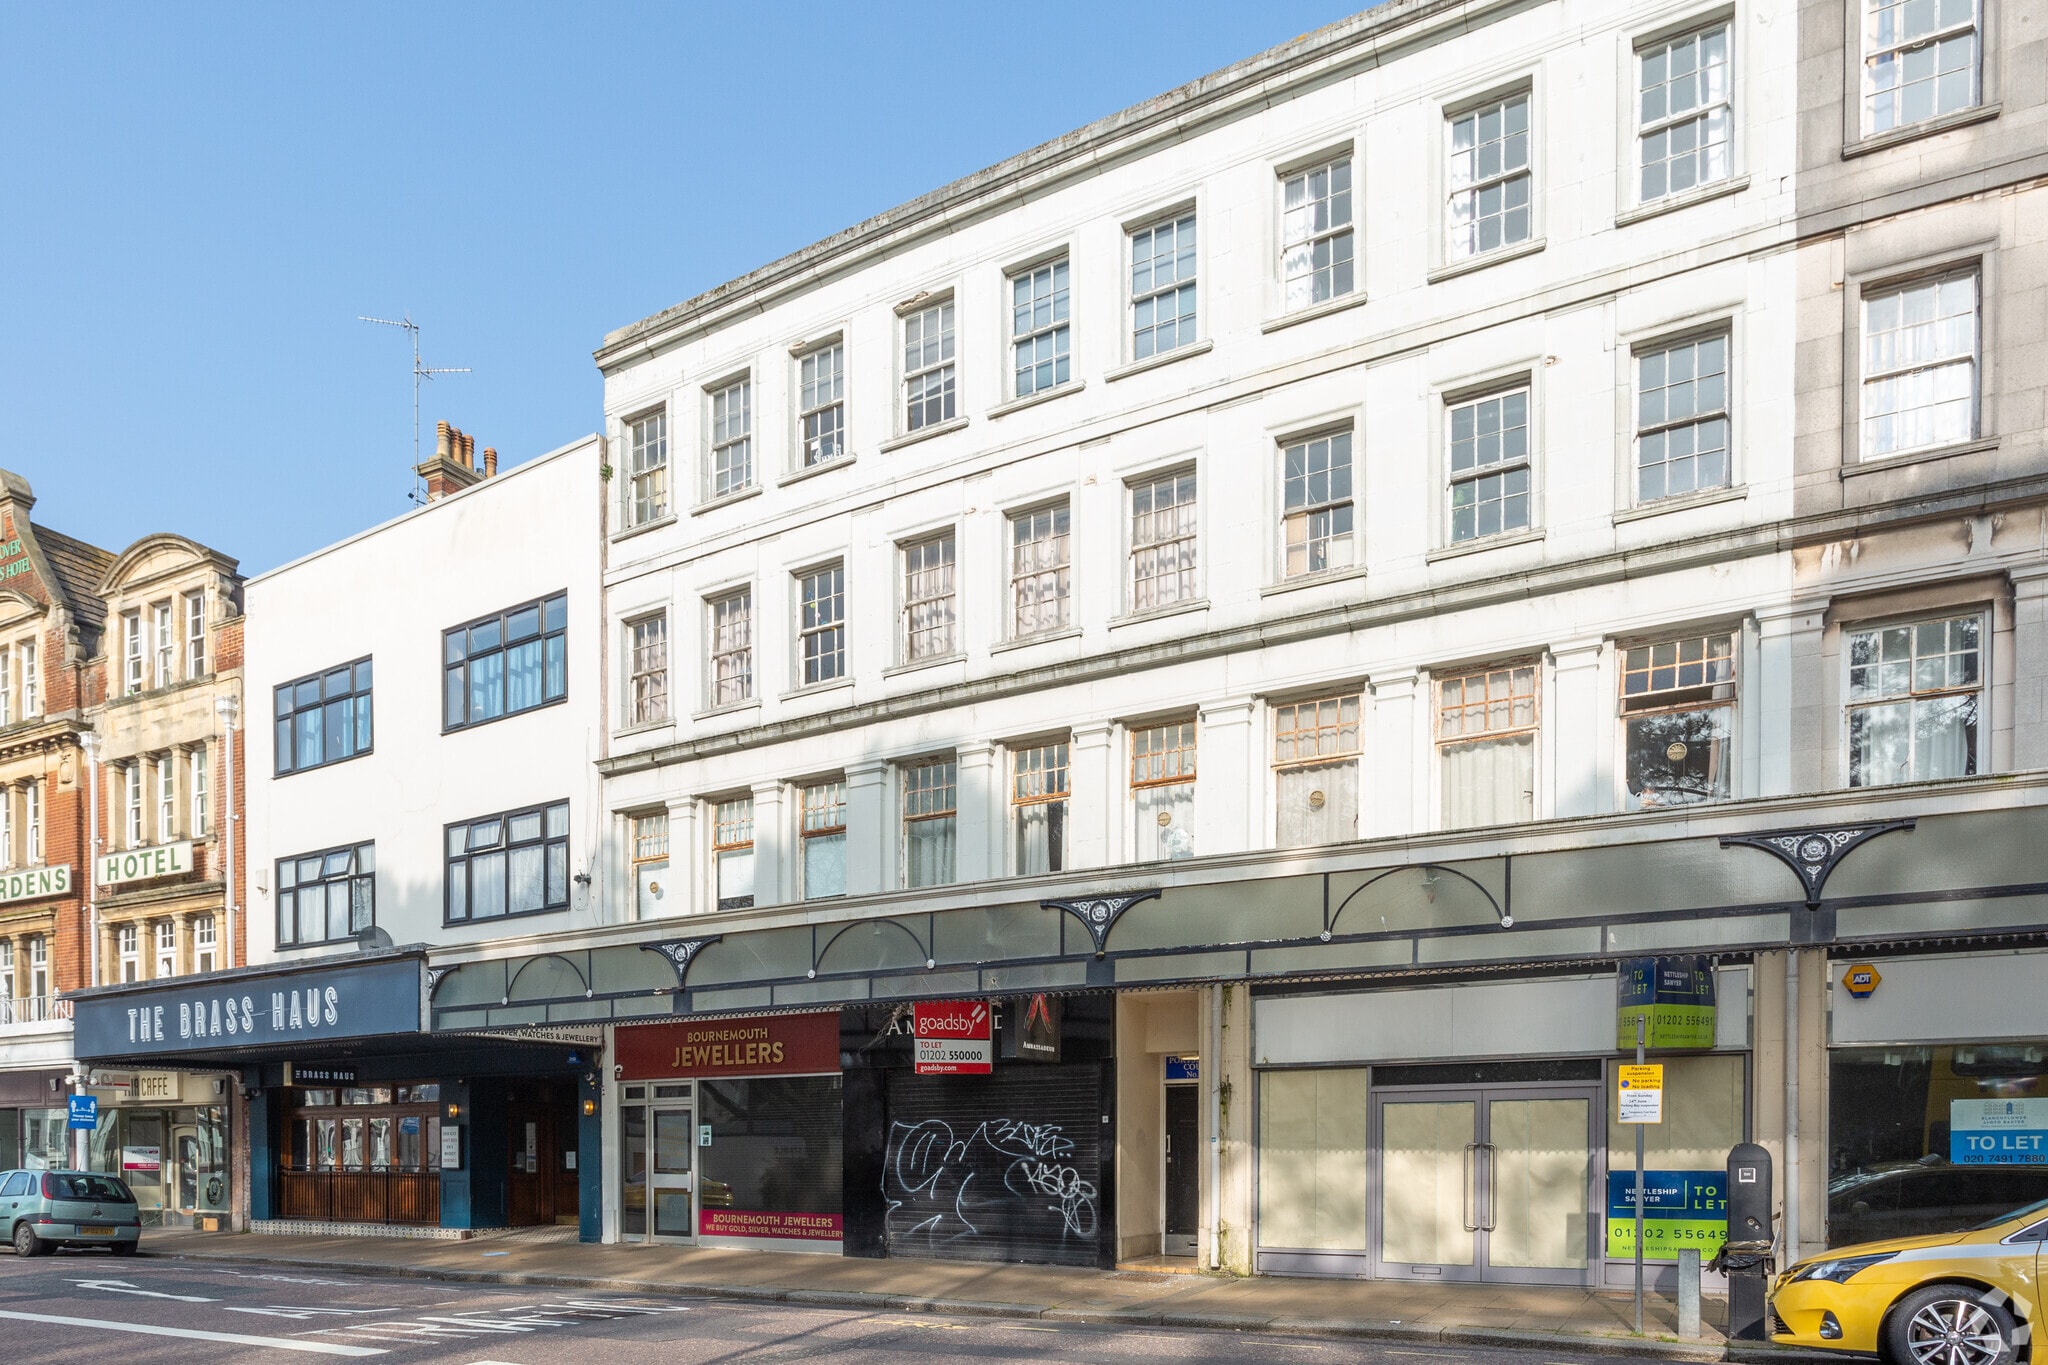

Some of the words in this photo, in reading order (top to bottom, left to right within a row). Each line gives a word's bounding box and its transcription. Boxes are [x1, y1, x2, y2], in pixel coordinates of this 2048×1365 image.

[6, 557, 32, 579] HOTEL
[107, 847, 182, 882] HOTEL
[1634, 970, 1644, 980] TO
[1663, 970, 1689, 979] NETTLESHIP
[1694, 971, 1704, 981] TO
[1853, 974, 1871, 983] ADT
[1663, 979, 1682, 987] SAWYER
[1632, 983, 1648, 995] LET
[1695, 984, 1709, 995] LET
[127, 1005, 164, 1043] THE
[179, 996, 254, 1039] BRASS
[272, 986, 338, 1031] HAUS
[1657, 1014, 1683, 1025] 01202
[1685, 1015, 1713, 1026] 556491
[919, 1012, 976, 1036] goadsby
[520, 1029, 554, 1040] WATCHES
[562, 1033, 599, 1043] JEWELLERY
[687, 1027, 768, 1043] BOURNEMOUTH
[920, 1041, 930, 1049] TO
[931, 1041, 942, 1049] LET
[671, 1041, 785, 1068] JEWELLERS
[920, 1050, 946, 1060] 01202
[949, 1050, 983, 1061] 550000
[920, 1064, 957, 1073] goadsby.com
[302, 1070, 330, 1079] BRASS
[333, 1072, 355, 1081] HAUS
[141, 1073, 168, 1097] CAFFÈ
[1966, 1135, 1996, 1150] TO
[2002, 1135, 2043, 1150] LET
[1963, 1155, 1984, 1163] 020
[1988, 1154, 2013, 1163] 7491
[2018, 1154, 2046, 1163] 7880
[1694, 1186, 1717, 1197] TO
[1625, 1195, 1661, 1203] SAYER
[1694, 1199, 1728, 1210] LET
[713, 1213, 780, 1225] BOURNEMOUTH
[783, 1216, 833, 1228] JEWELLERS
[705, 1223, 716, 1231] WE
[728, 1224, 748, 1233] GOLD,
[748, 1226, 771, 1234] SILVER,
[771, 1227, 801, 1236] WATCHES
[802, 1228, 807, 1236] &
[807, 1228, 843, 1238] JEWELLERY
[1614, 1228, 1665, 1239] 0102
